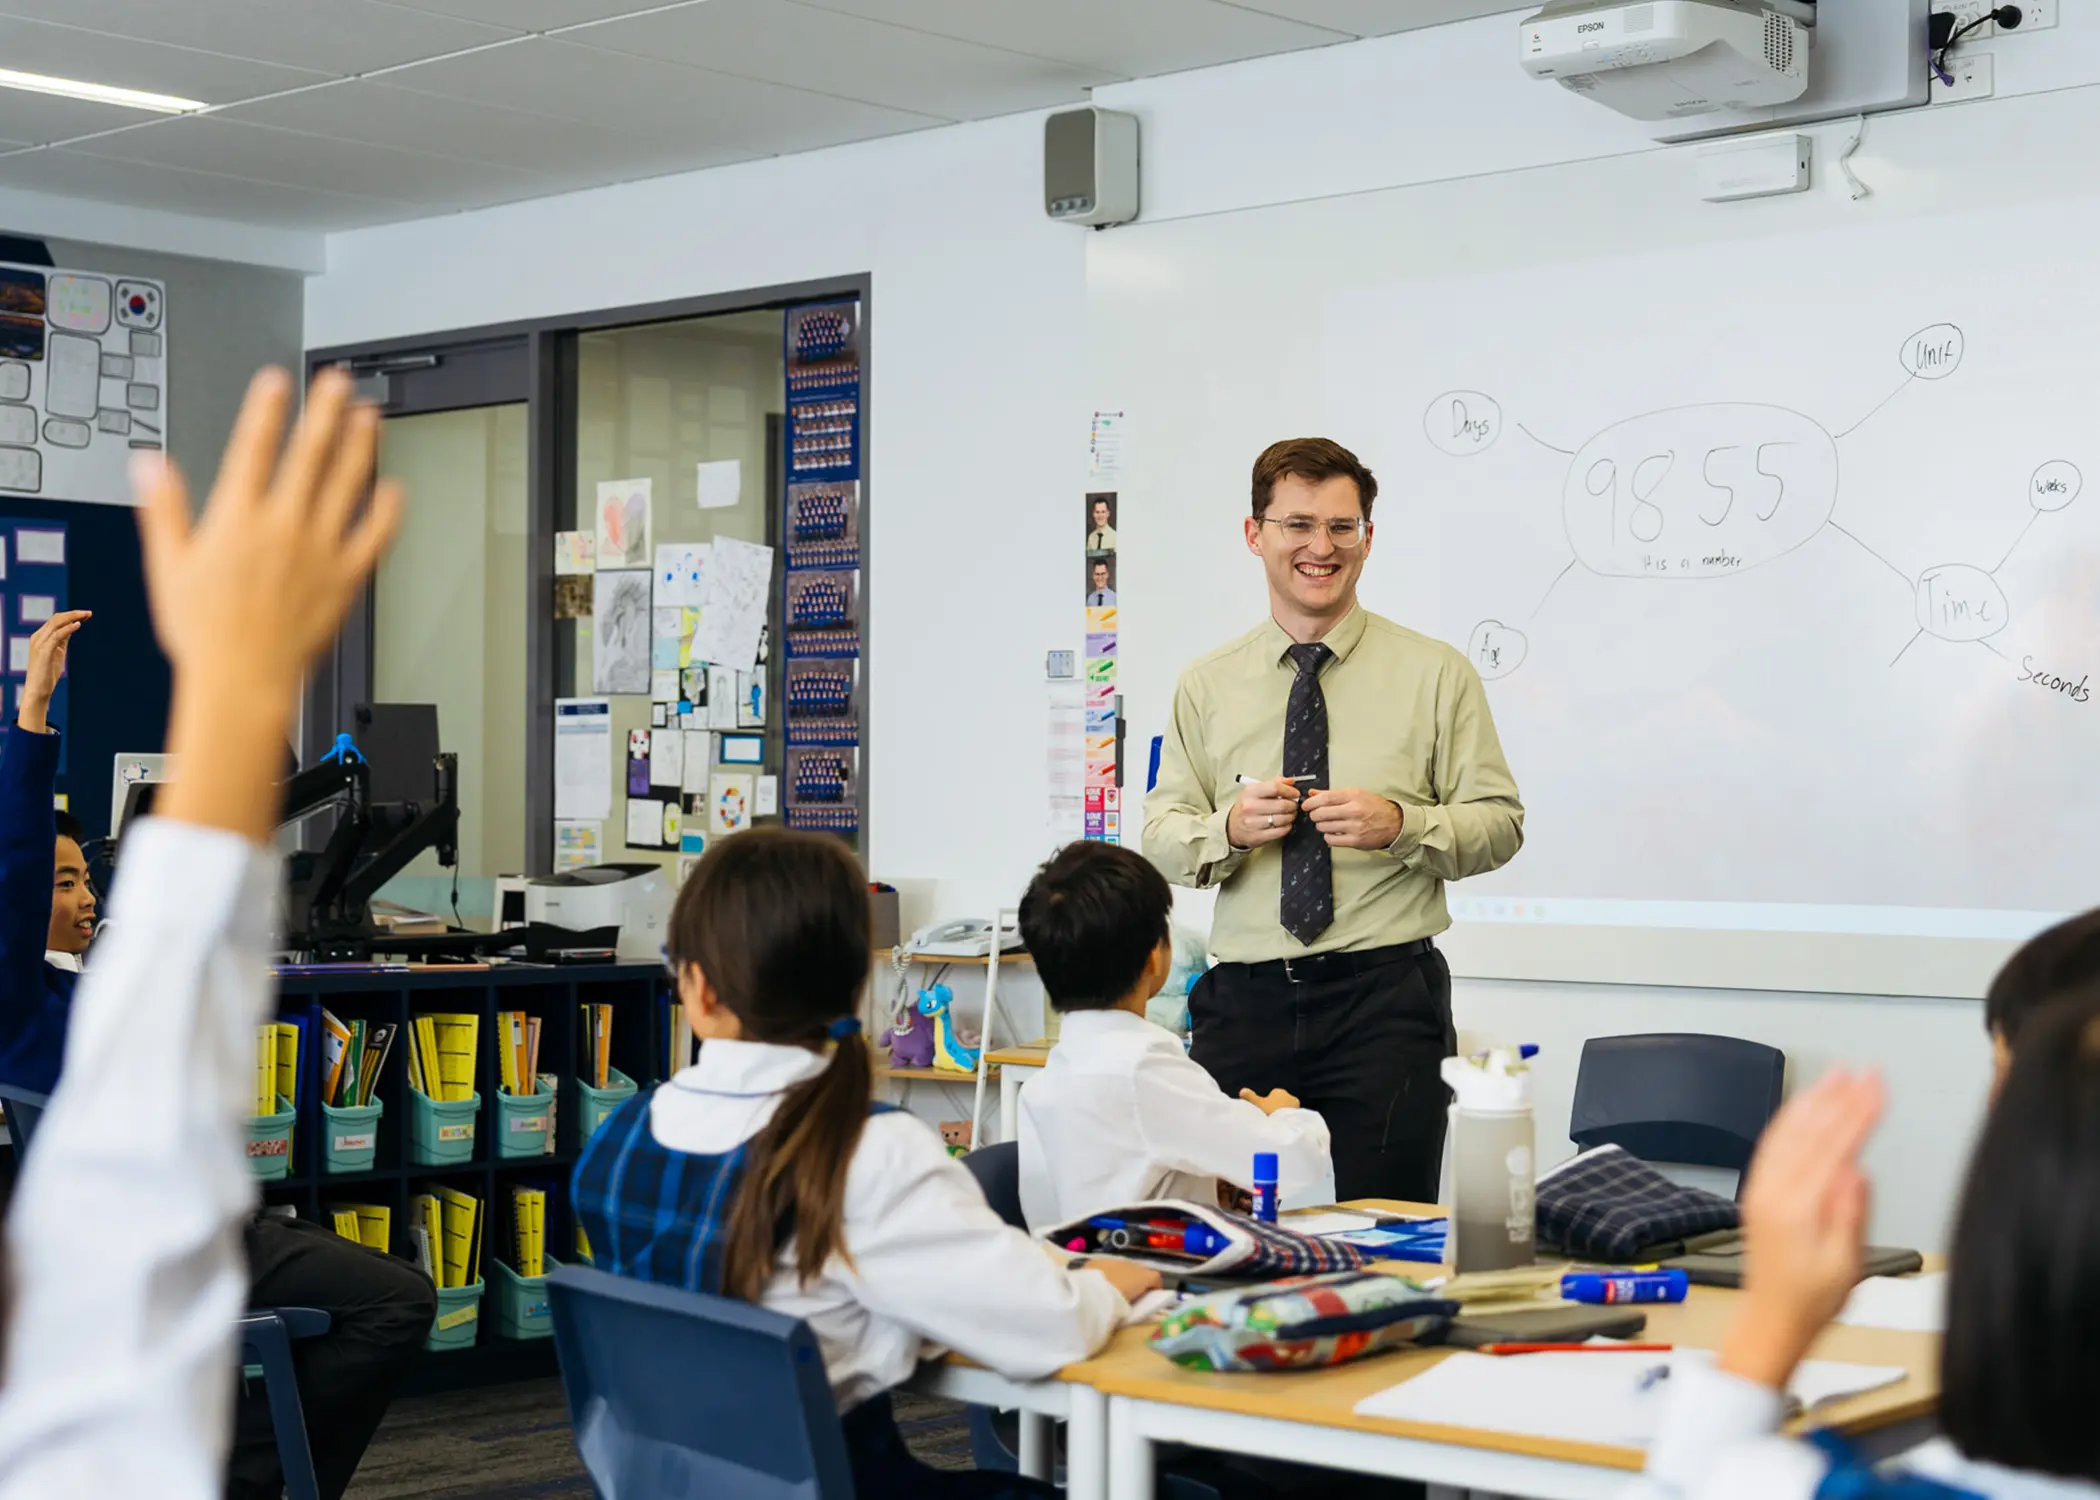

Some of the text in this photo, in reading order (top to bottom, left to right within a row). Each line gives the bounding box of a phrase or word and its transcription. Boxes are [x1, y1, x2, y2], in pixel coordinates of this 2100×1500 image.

[1577, 21, 1605, 34] EPSON
[1915, 340, 1953, 370] Unit
[1452, 399, 1490, 442] Days
[1680, 558, 1690, 570] a
[1701, 548, 1743, 568] number
[1922, 573, 1992, 628] Time
[1480, 632, 1500, 669] Age
[2017, 655, 2090, 702] Seconds
